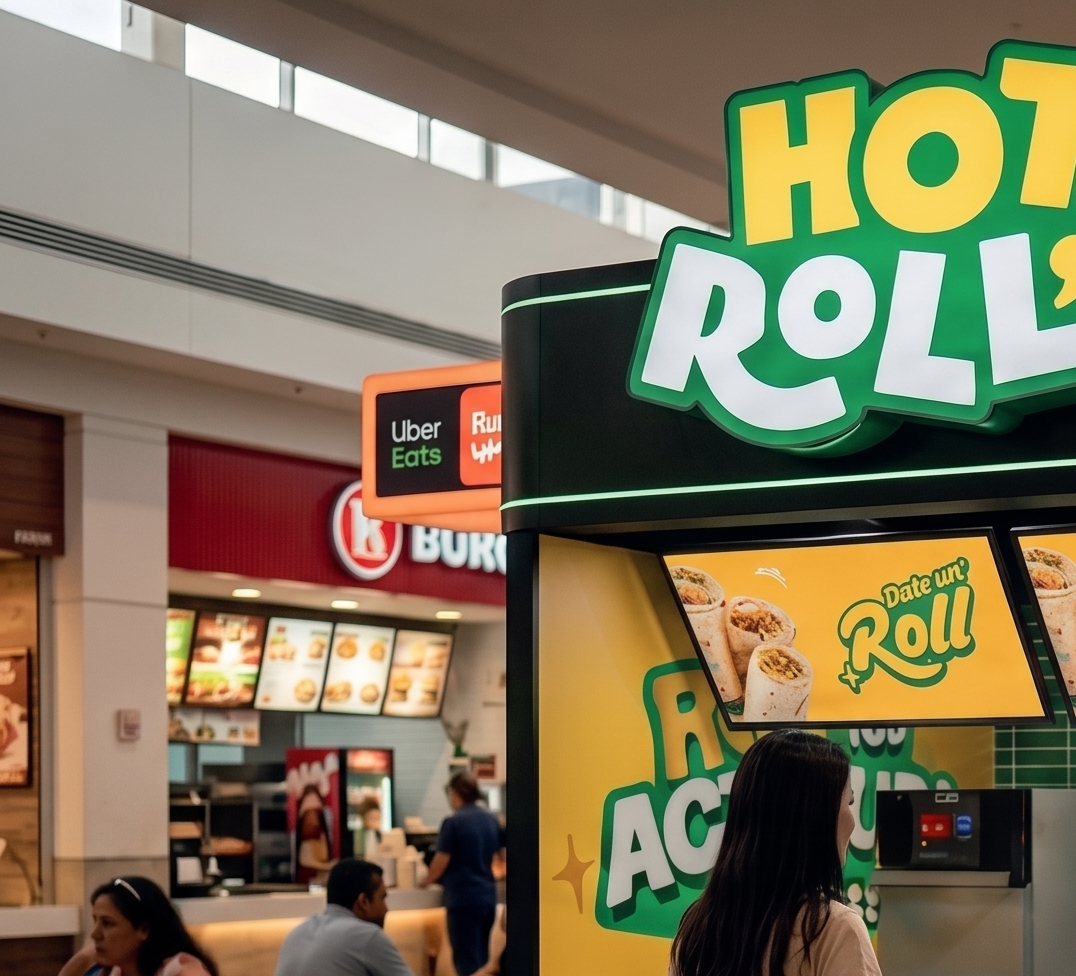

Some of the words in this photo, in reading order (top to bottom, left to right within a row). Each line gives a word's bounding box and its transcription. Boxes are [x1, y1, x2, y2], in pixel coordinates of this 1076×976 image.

[391, 419, 442, 443] Uber
[392, 445, 442, 469] Eats
[884, 577, 932, 608] Date
[840, 586, 971, 680] Roll
